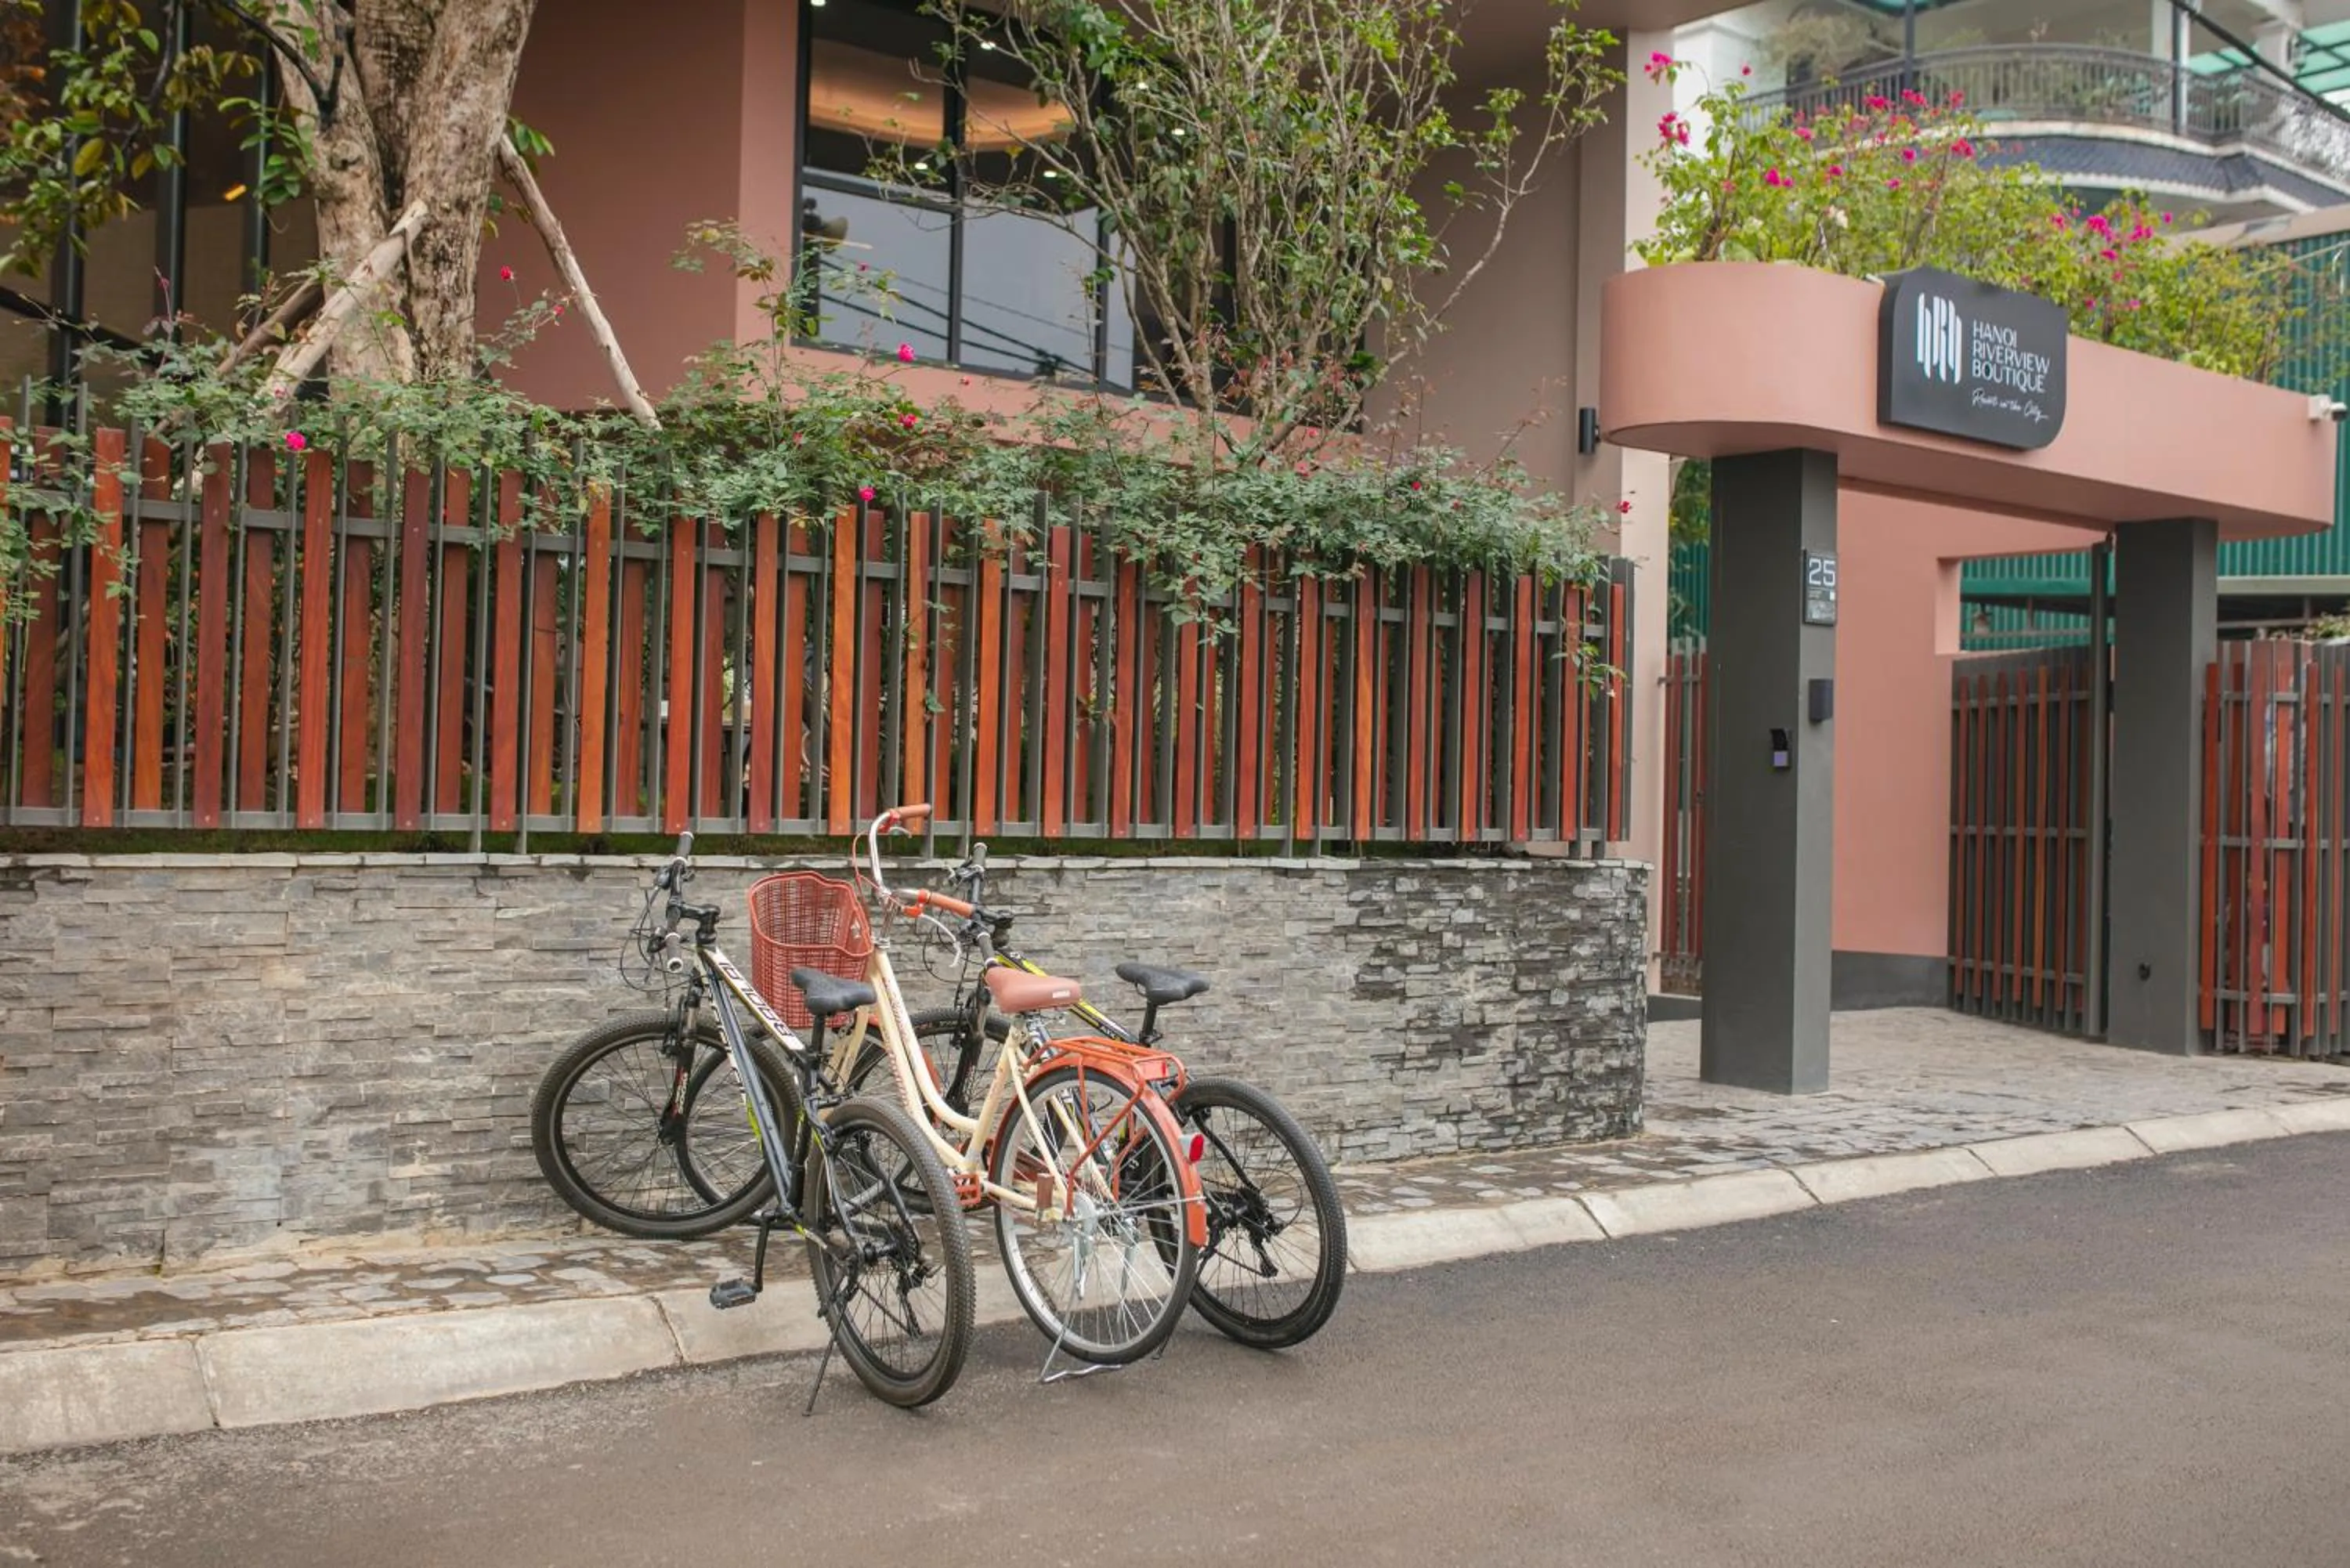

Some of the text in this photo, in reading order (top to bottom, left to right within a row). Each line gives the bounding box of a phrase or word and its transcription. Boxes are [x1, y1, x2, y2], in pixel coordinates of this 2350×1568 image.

[1972, 320, 2017, 348] HANOI
[1972, 339, 2050, 374] RIVERVIEW
[1972, 359, 2047, 392] BOUTIQUE
[1809, 557, 1835, 587] 25
